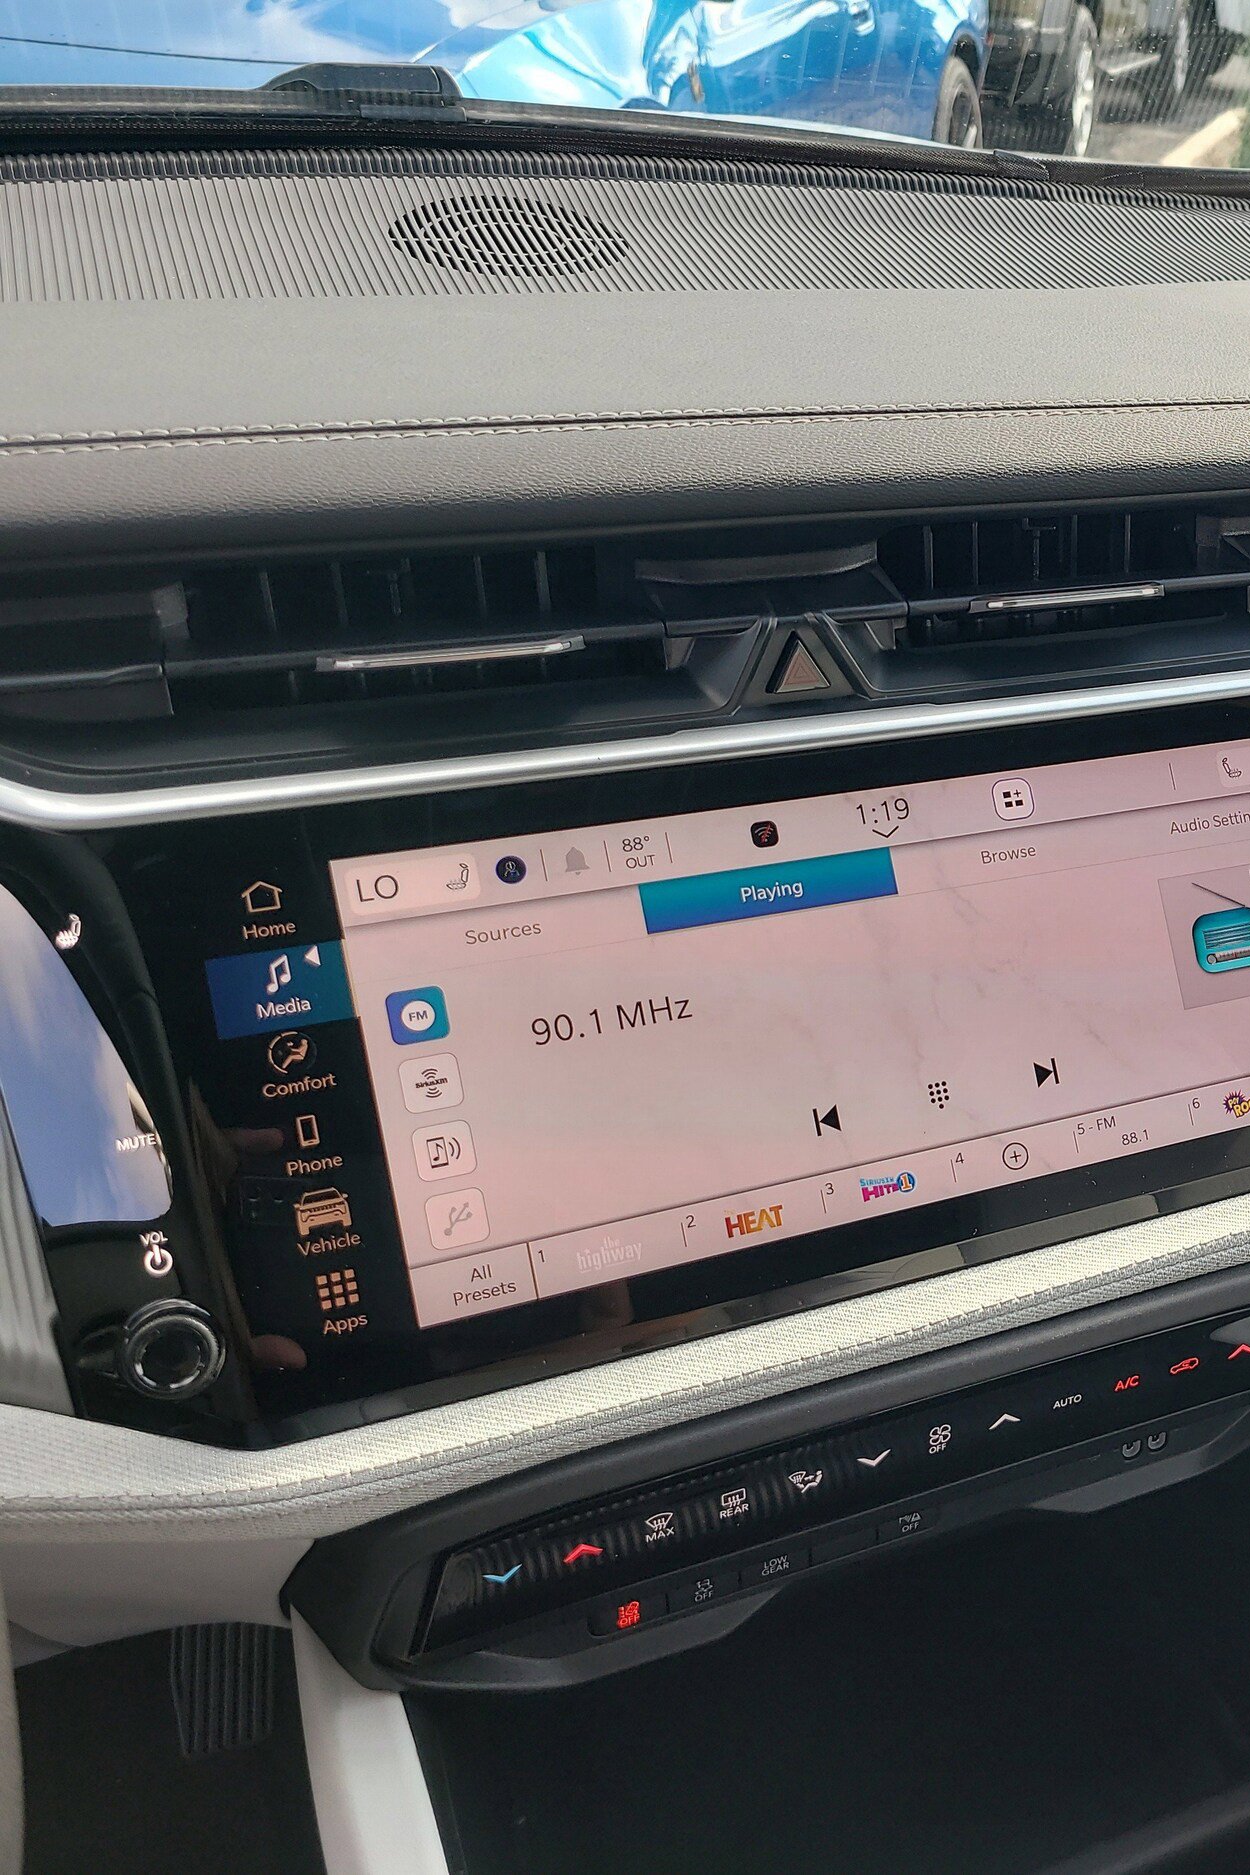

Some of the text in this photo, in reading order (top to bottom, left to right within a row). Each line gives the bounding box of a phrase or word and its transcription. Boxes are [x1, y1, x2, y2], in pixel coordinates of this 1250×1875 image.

[855, 797, 911, 826] 1:19
[1169, 815, 1211, 835] Audio
[622, 835, 651, 853] 88°
[625, 854, 657, 870] OUT
[980, 843, 1037, 865] Browse
[355, 874, 399, 903] LO
[740, 879, 805, 904] Playing
[243, 920, 297, 940] Home
[465, 920, 542, 945] Sources
[256, 997, 311, 1019] Media
[408, 1009, 429, 1023] FM
[531, 996, 693, 1046] 90.1 MHz
[262, 1073, 336, 1098] Comfort
[1192, 1098, 1201, 1110] 6
[1077, 1123, 1086, 1136] 5
[1096, 1116, 1117, 1132] FM
[115, 1134, 157, 1151] MUTE
[1121, 1129, 1150, 1146] 88.1
[286, 1153, 343, 1177] Phone
[954, 1153, 965, 1166] 4
[825, 1183, 835, 1196] 3
[686, 1214, 696, 1228] 2
[725, 1205, 782, 1238] HEAT
[139, 1231, 168, 1245] VOL
[296, 1232, 361, 1256] Vehicle
[538, 1249, 546, 1263] 1
[576, 1242, 642, 1271] highway
[469, 1264, 492, 1282] All
[453, 1279, 517, 1306] Presets
[322, 1312, 368, 1336] Apps
[1114, 1374, 1140, 1392] A/C
[1052, 1393, 1083, 1410] AUTO
[929, 1443, 947, 1454] OFF
[719, 1502, 749, 1520] REAR
[645, 1526, 676, 1543] MAX
[902, 1522, 919, 1533] OFF
[761, 1561, 791, 1577] GEAR
[763, 1554, 788, 1568] LOW
[694, 1590, 713, 1602] OFF
[618, 1613, 640, 1627] OFF
